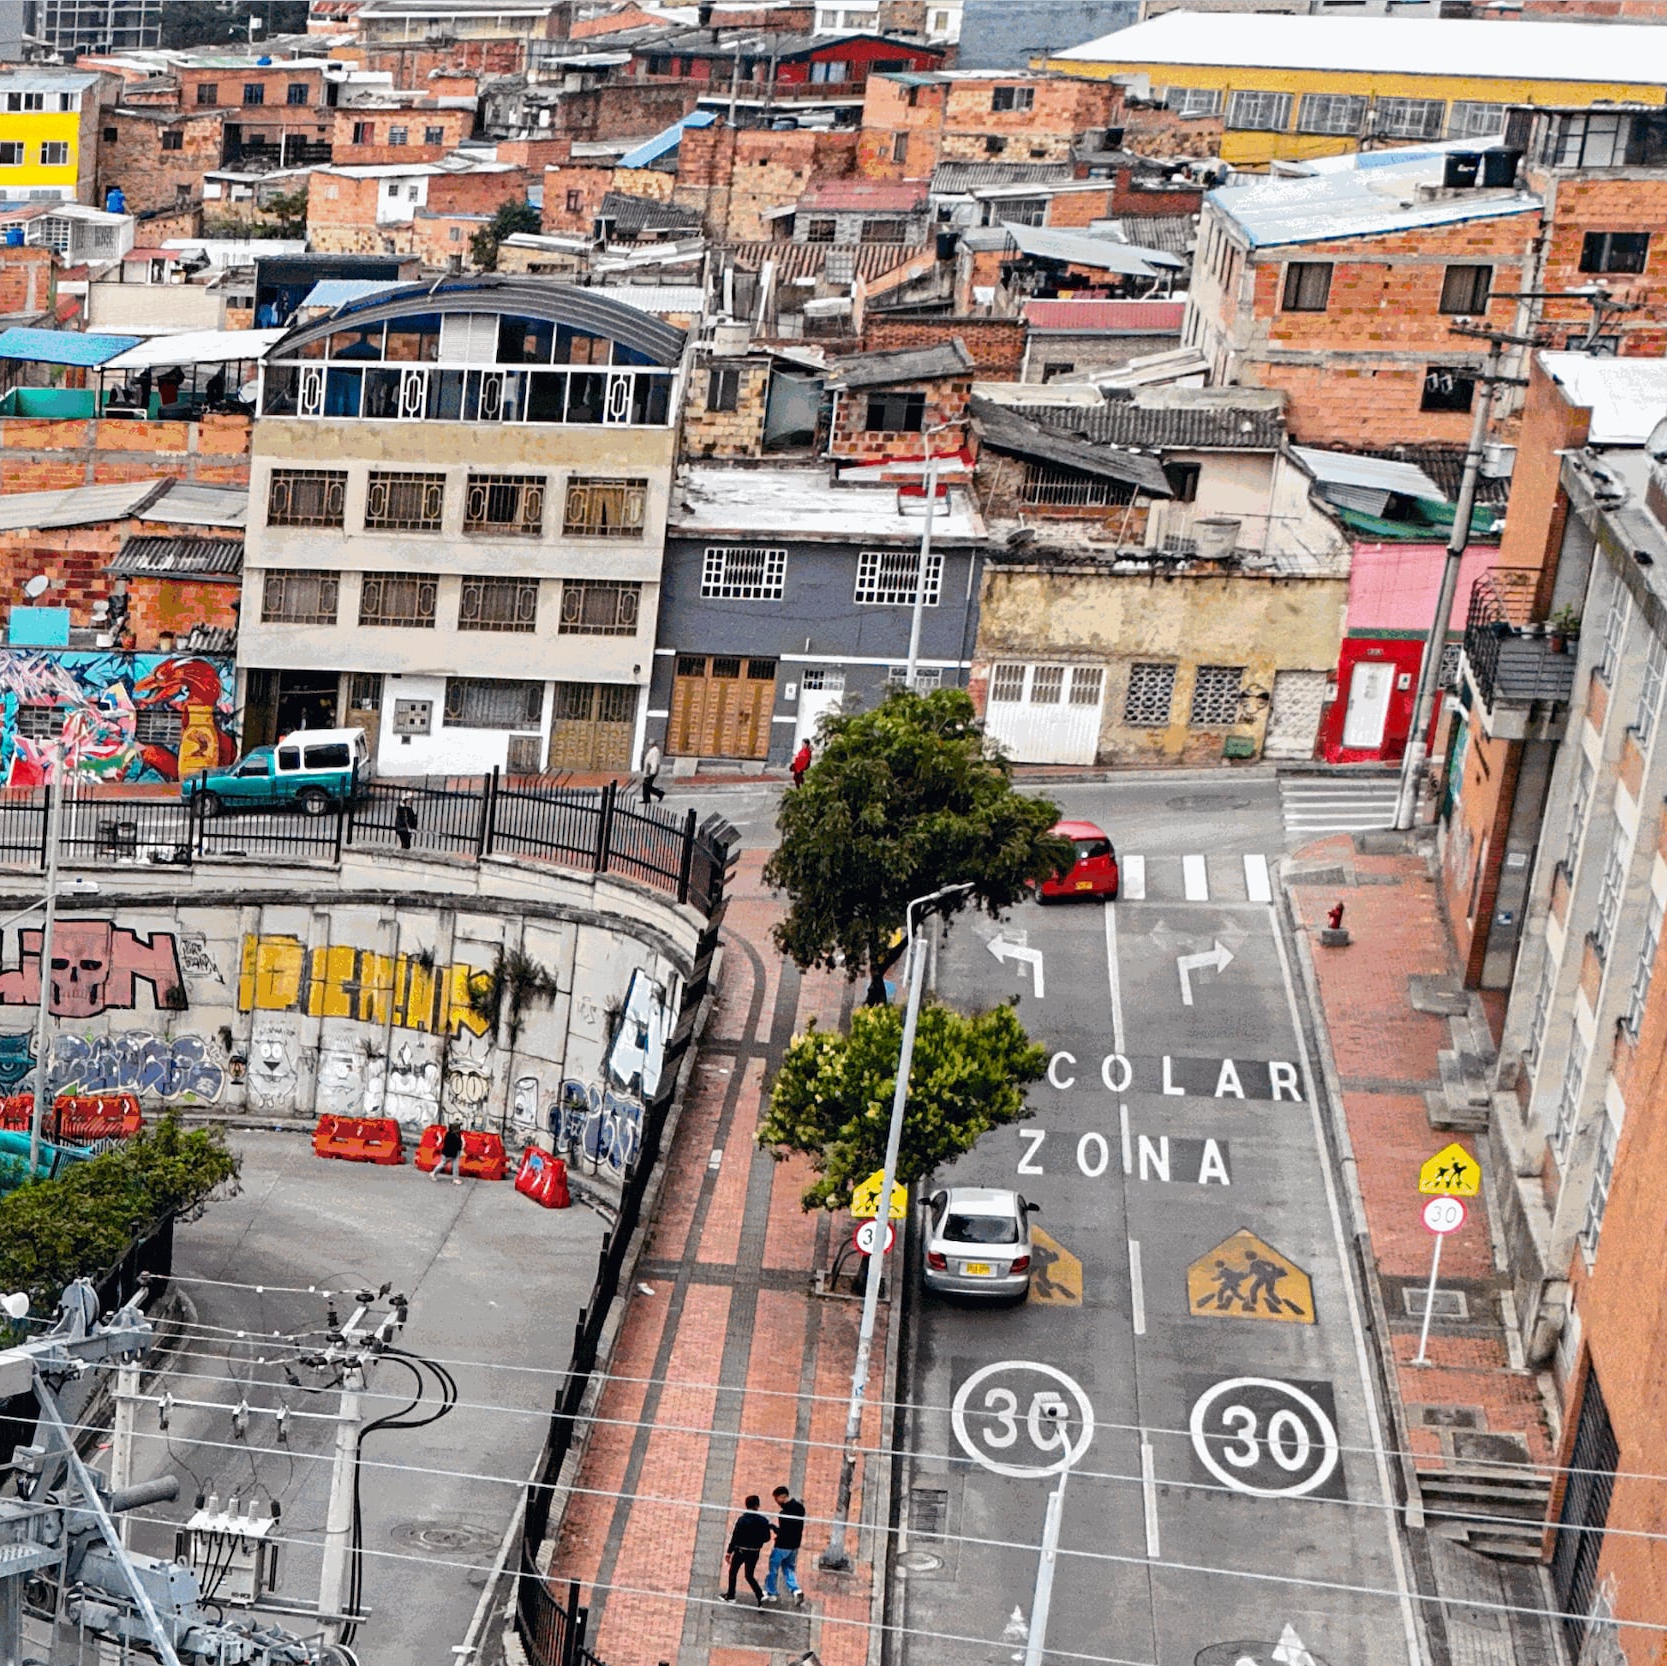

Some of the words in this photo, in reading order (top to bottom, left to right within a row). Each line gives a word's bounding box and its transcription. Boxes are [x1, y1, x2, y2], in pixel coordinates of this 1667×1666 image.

[1047, 1051, 1303, 1102] COLAR
[1017, 1128, 1231, 1186] ZONA
[1431, 1205, 1457, 1224] 30
[982, 1387, 1065, 1452] 30
[1222, 1405, 1310, 1472] 30
